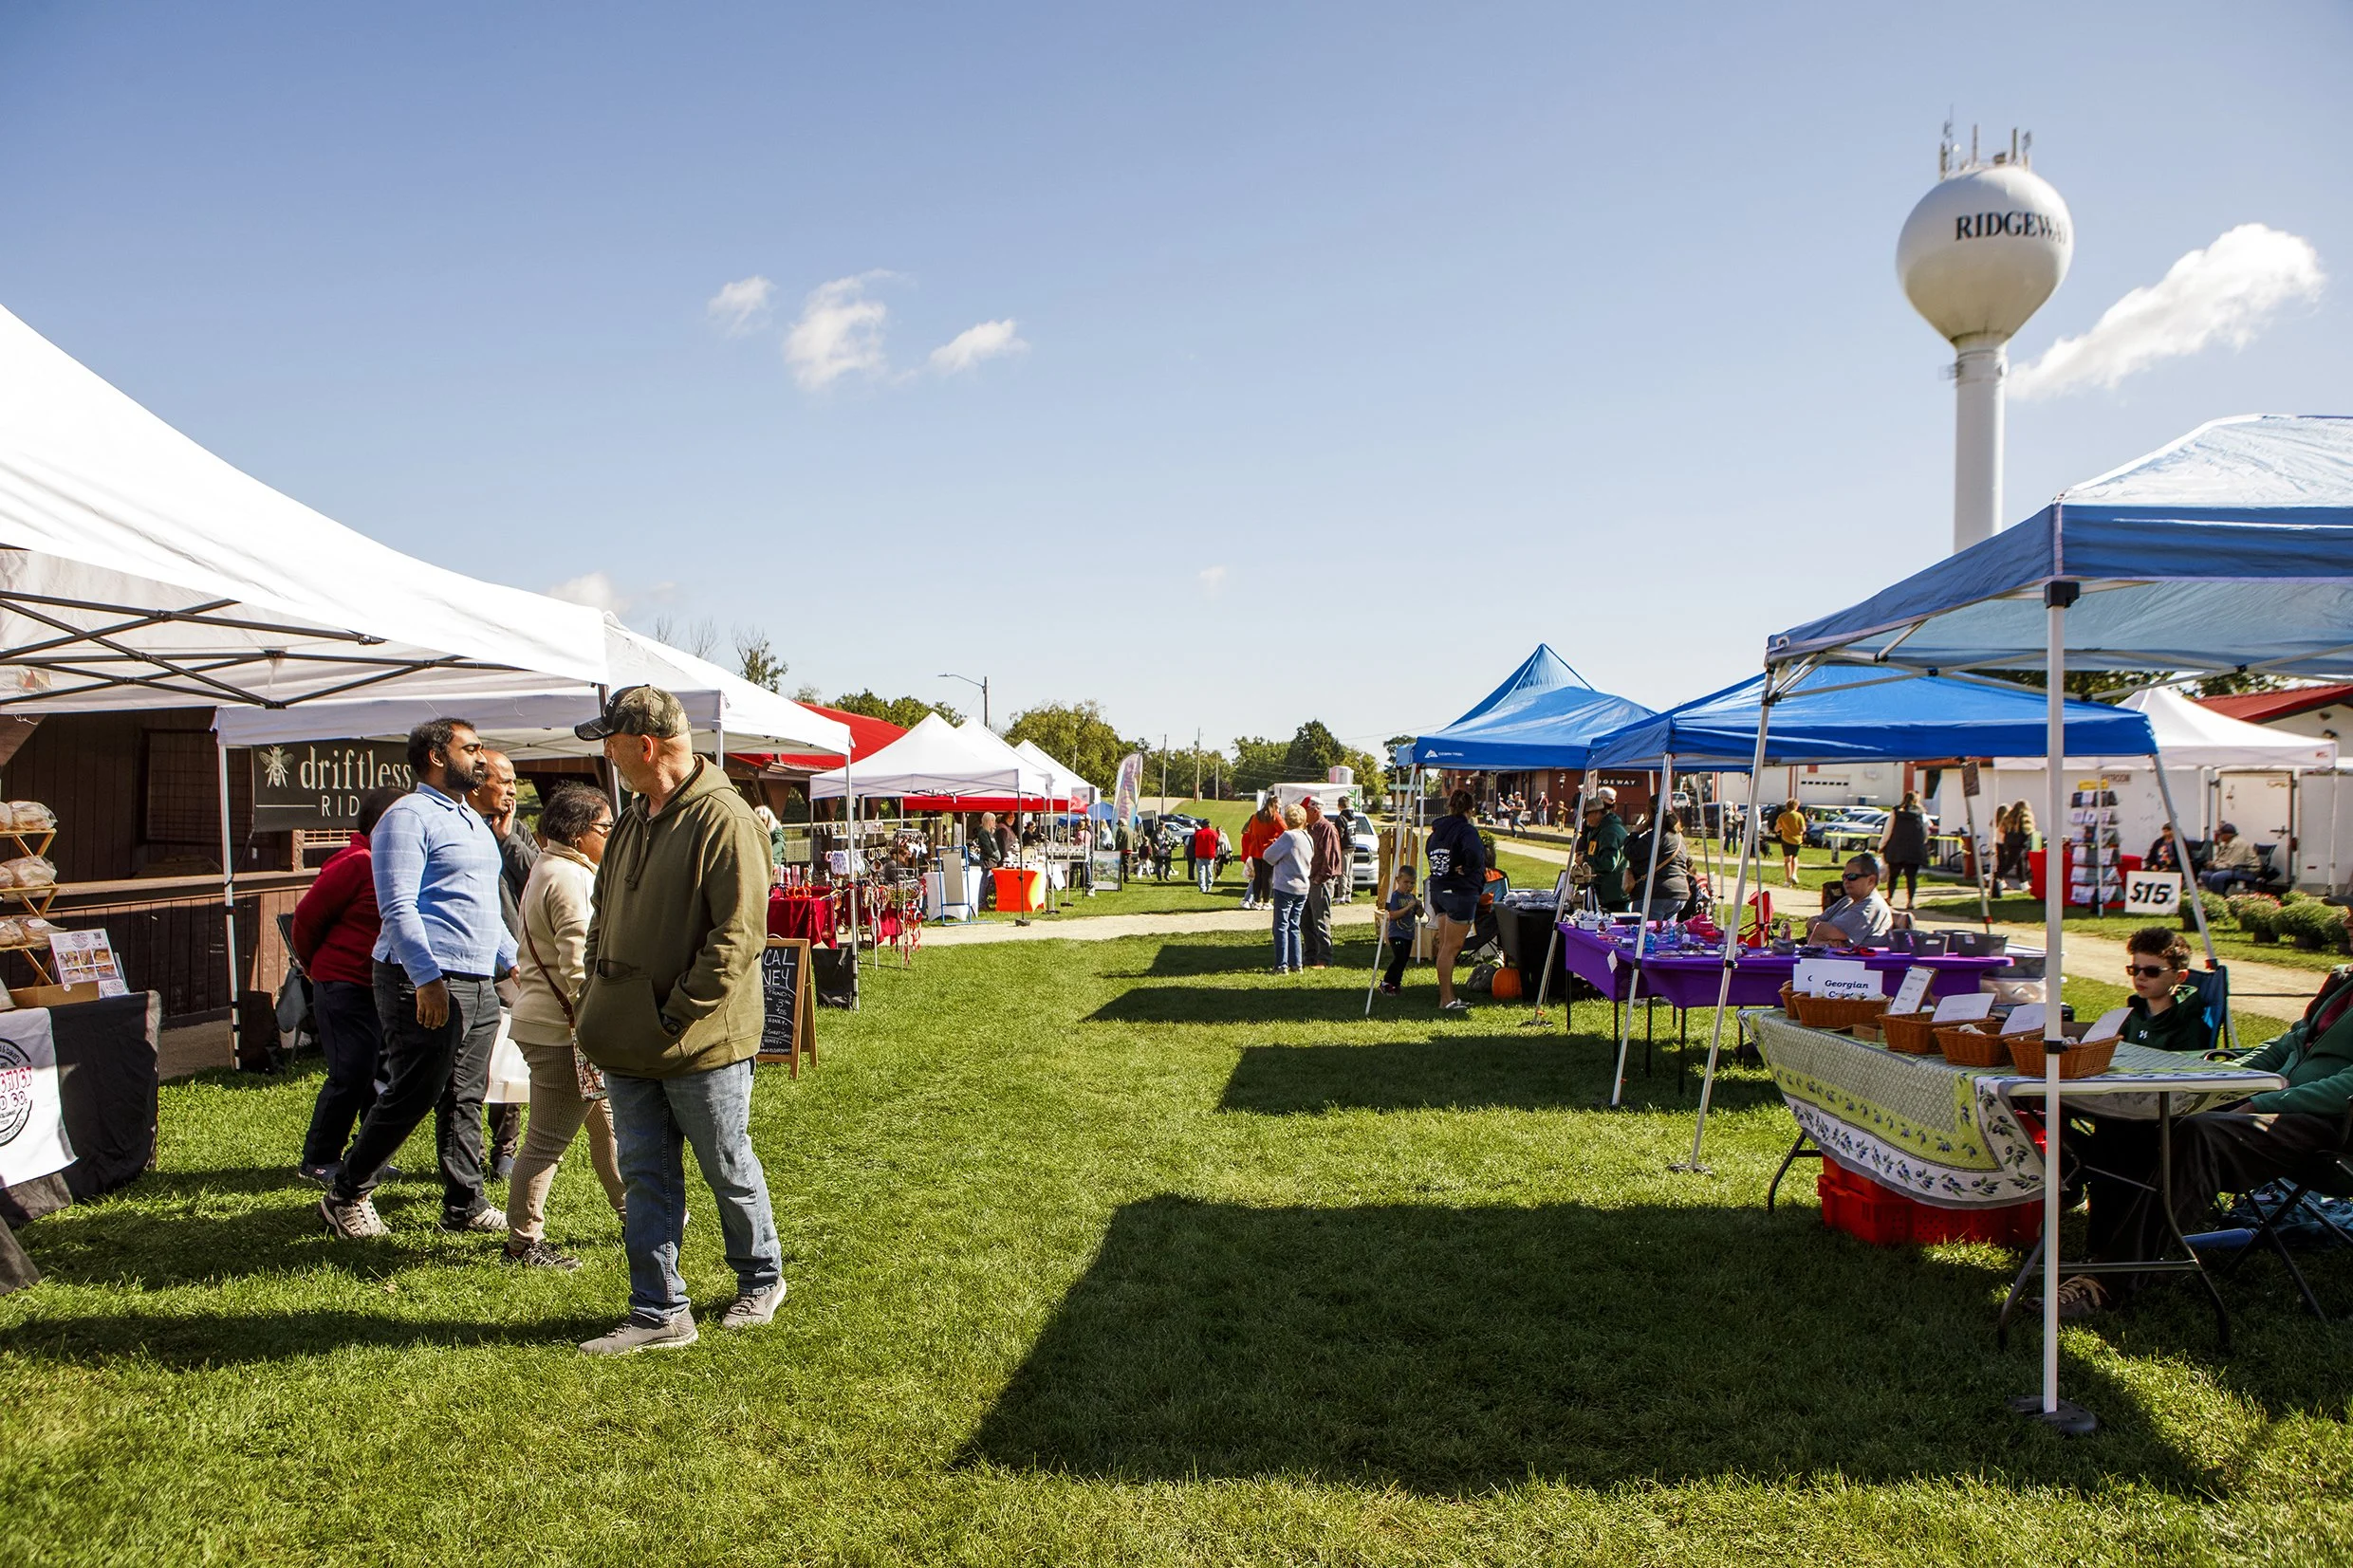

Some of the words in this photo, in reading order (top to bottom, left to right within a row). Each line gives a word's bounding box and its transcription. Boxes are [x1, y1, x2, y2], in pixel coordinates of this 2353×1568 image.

[300, 745, 412, 790] driftless
[2130, 881, 2171, 905] $15
[762, 949, 795, 966] CAL
[1825, 979, 1869, 989] Georgian
